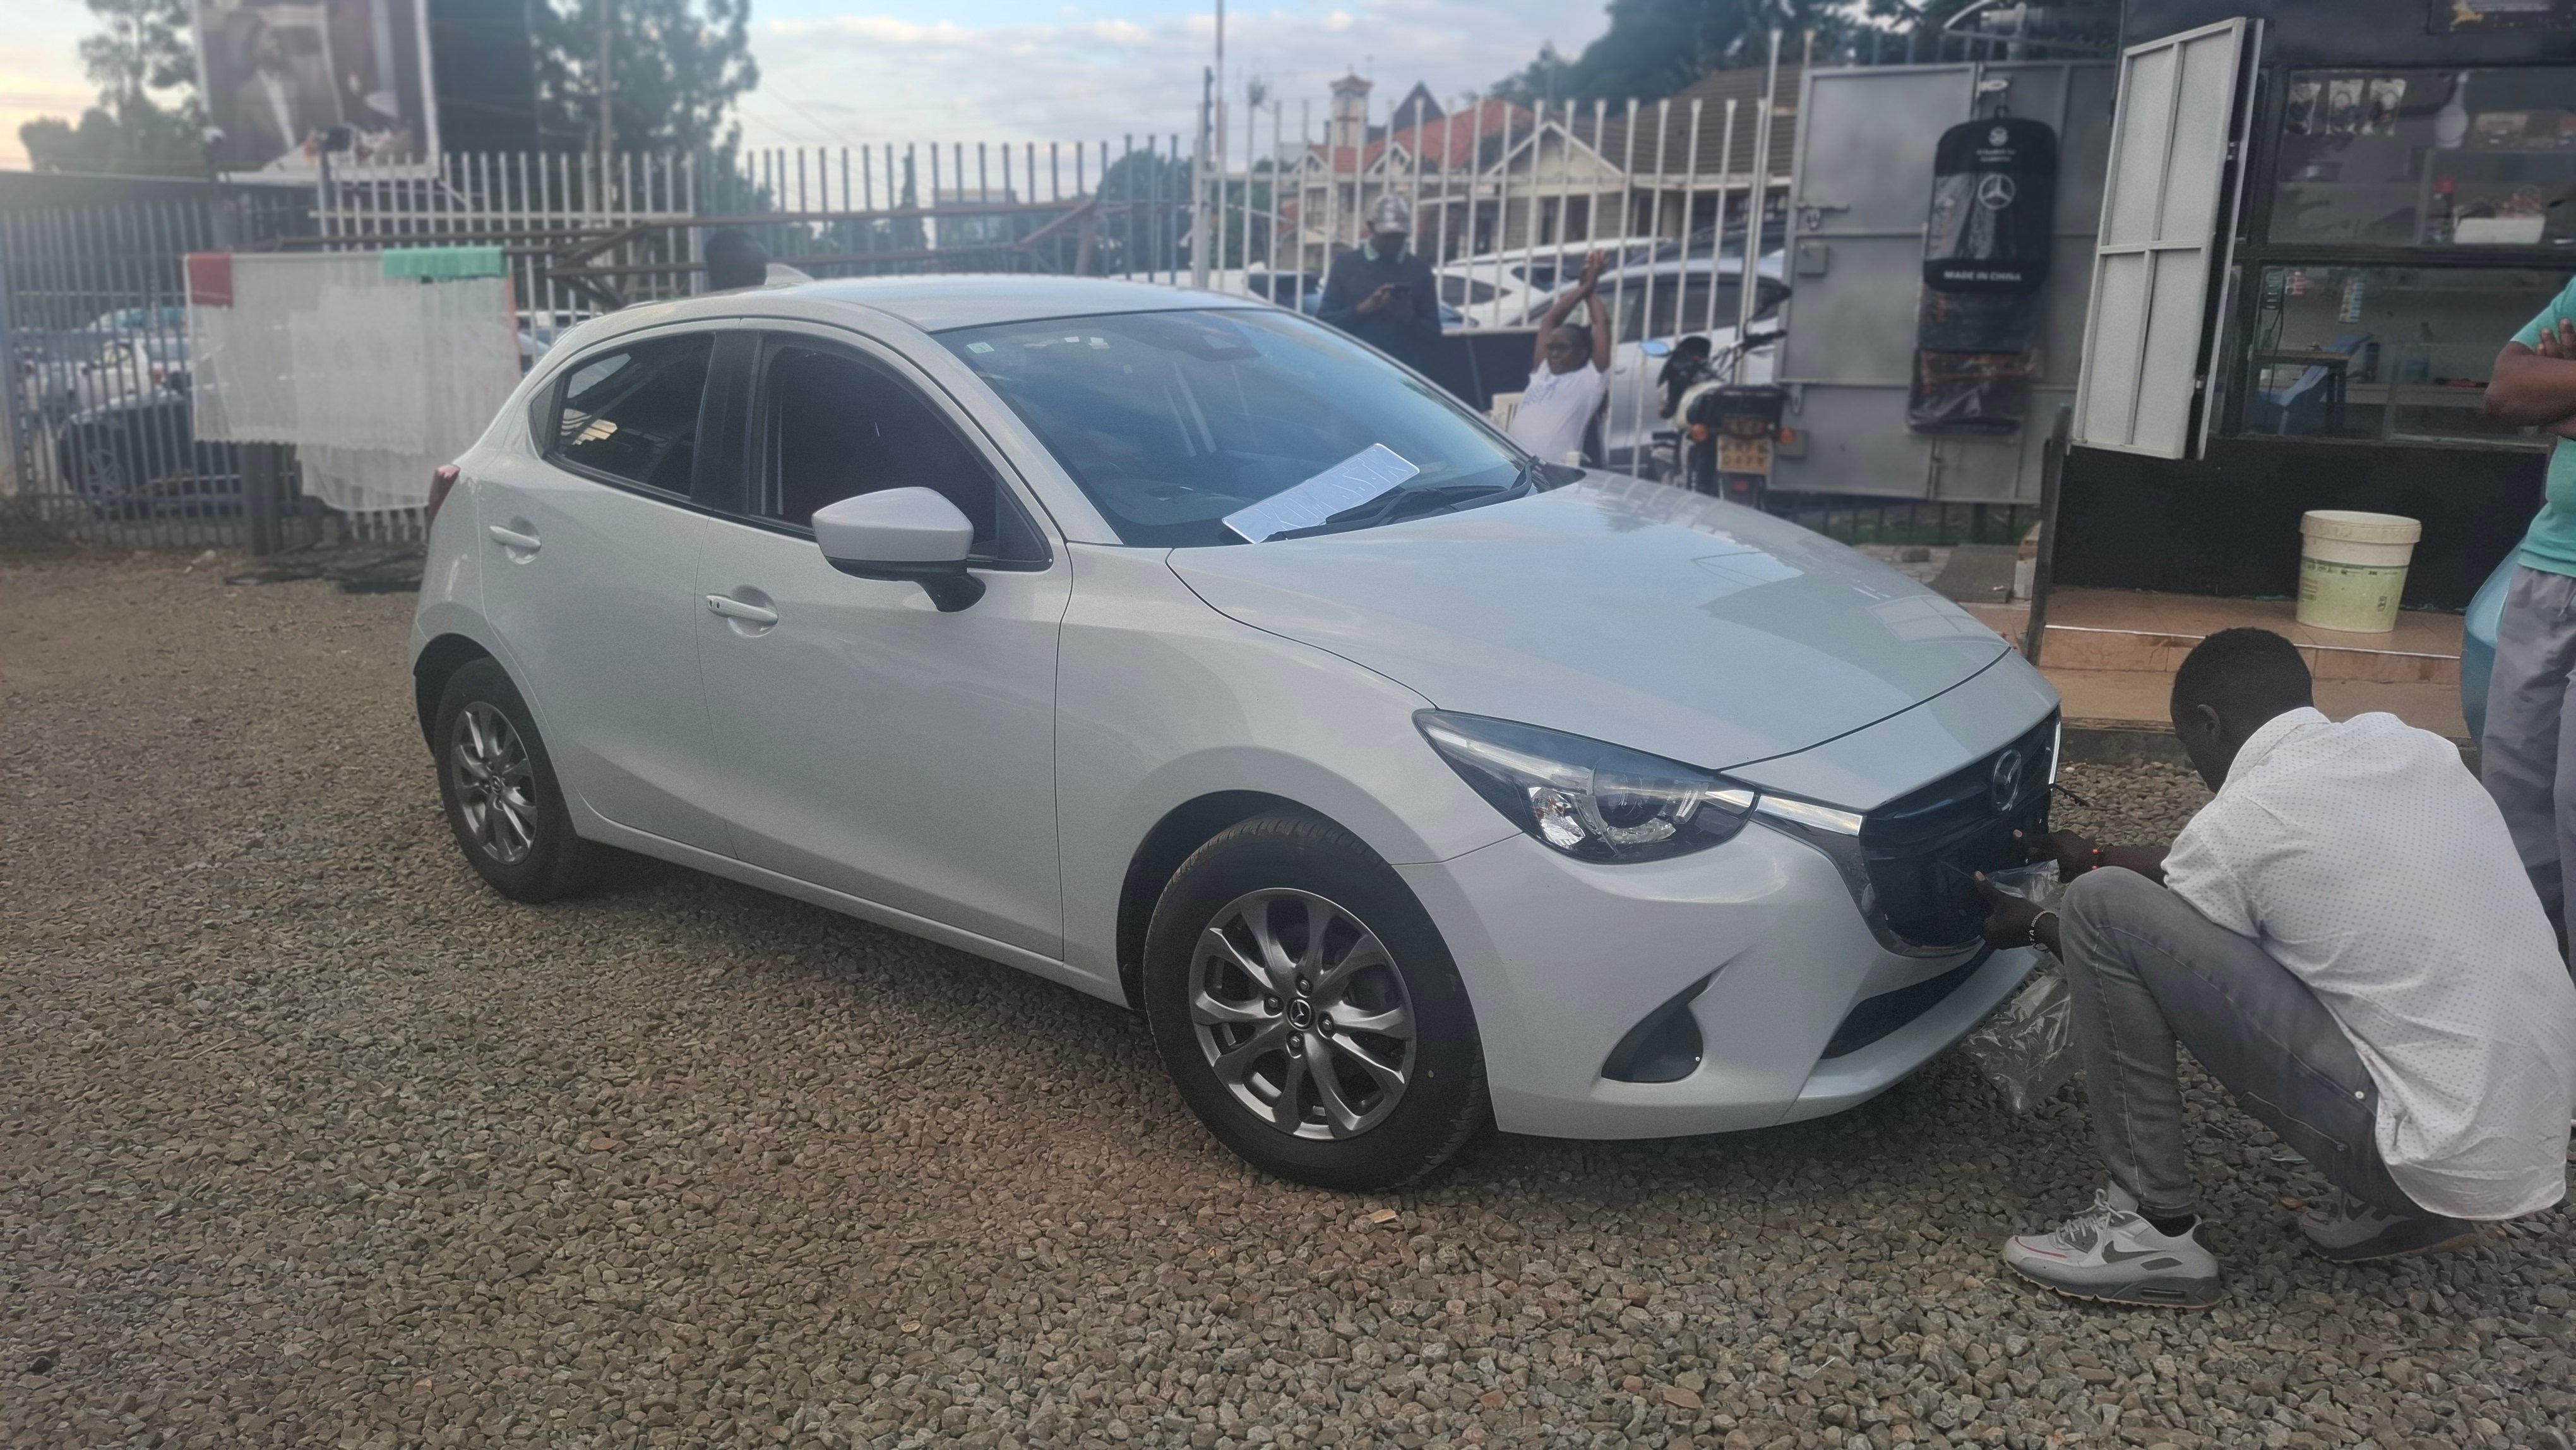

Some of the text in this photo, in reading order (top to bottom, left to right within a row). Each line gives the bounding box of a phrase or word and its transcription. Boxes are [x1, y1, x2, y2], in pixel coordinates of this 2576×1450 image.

[1943, 270, 2022, 282] MADE IN CHINA
